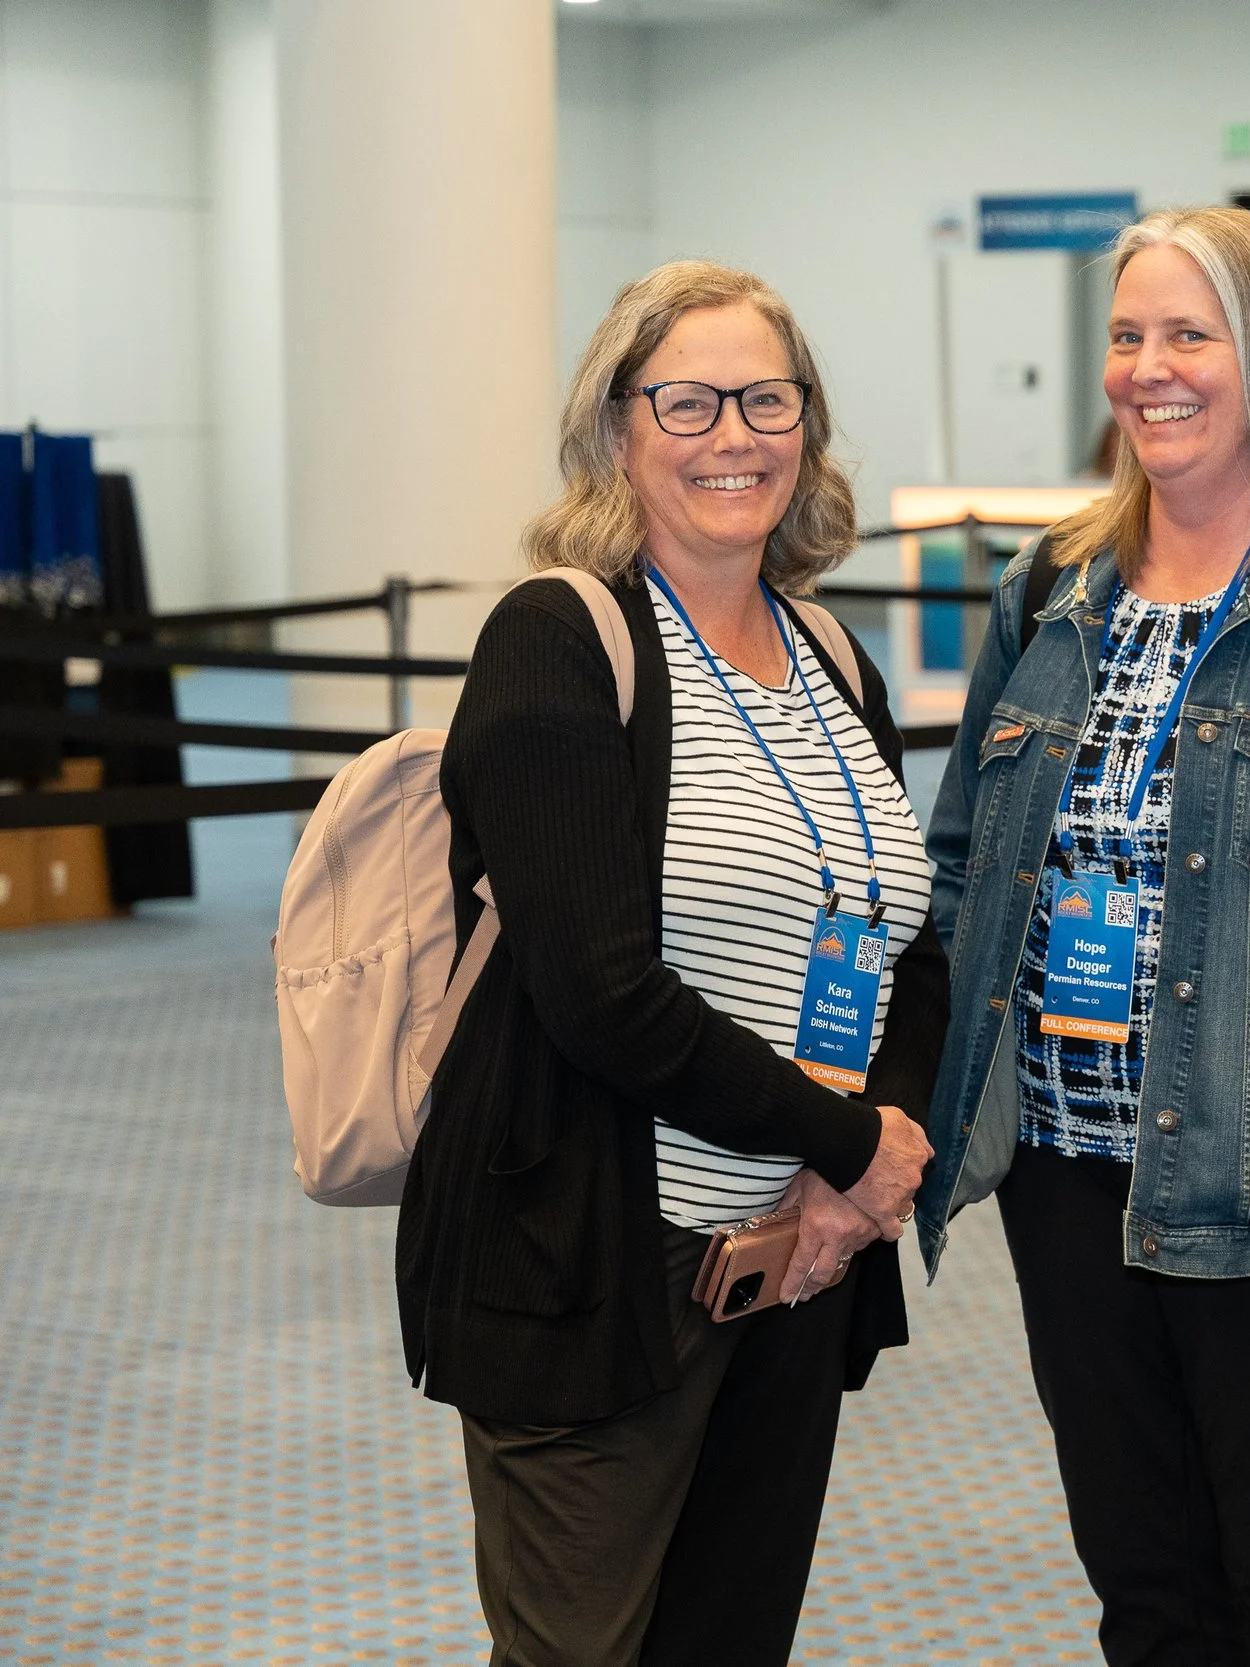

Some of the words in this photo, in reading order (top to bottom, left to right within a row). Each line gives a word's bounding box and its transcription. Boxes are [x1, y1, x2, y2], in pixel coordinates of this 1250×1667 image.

[1075, 939, 1106, 954] Hope
[1067, 957, 1112, 975] Dugger
[828, 981, 851, 1000] Kara
[1048, 973, 1082, 985] Permian
[1083, 977, 1127, 991] Resources
[815, 1000, 859, 1021] Schmidt
[810, 1016, 828, 1030] DISH
[829, 1022, 858, 1037] Network
[1041, 1017, 1064, 1029] FULL
[1066, 1021, 1128, 1037] CONFERENCE
[813, 1067, 866, 1087] CONFERENCE
